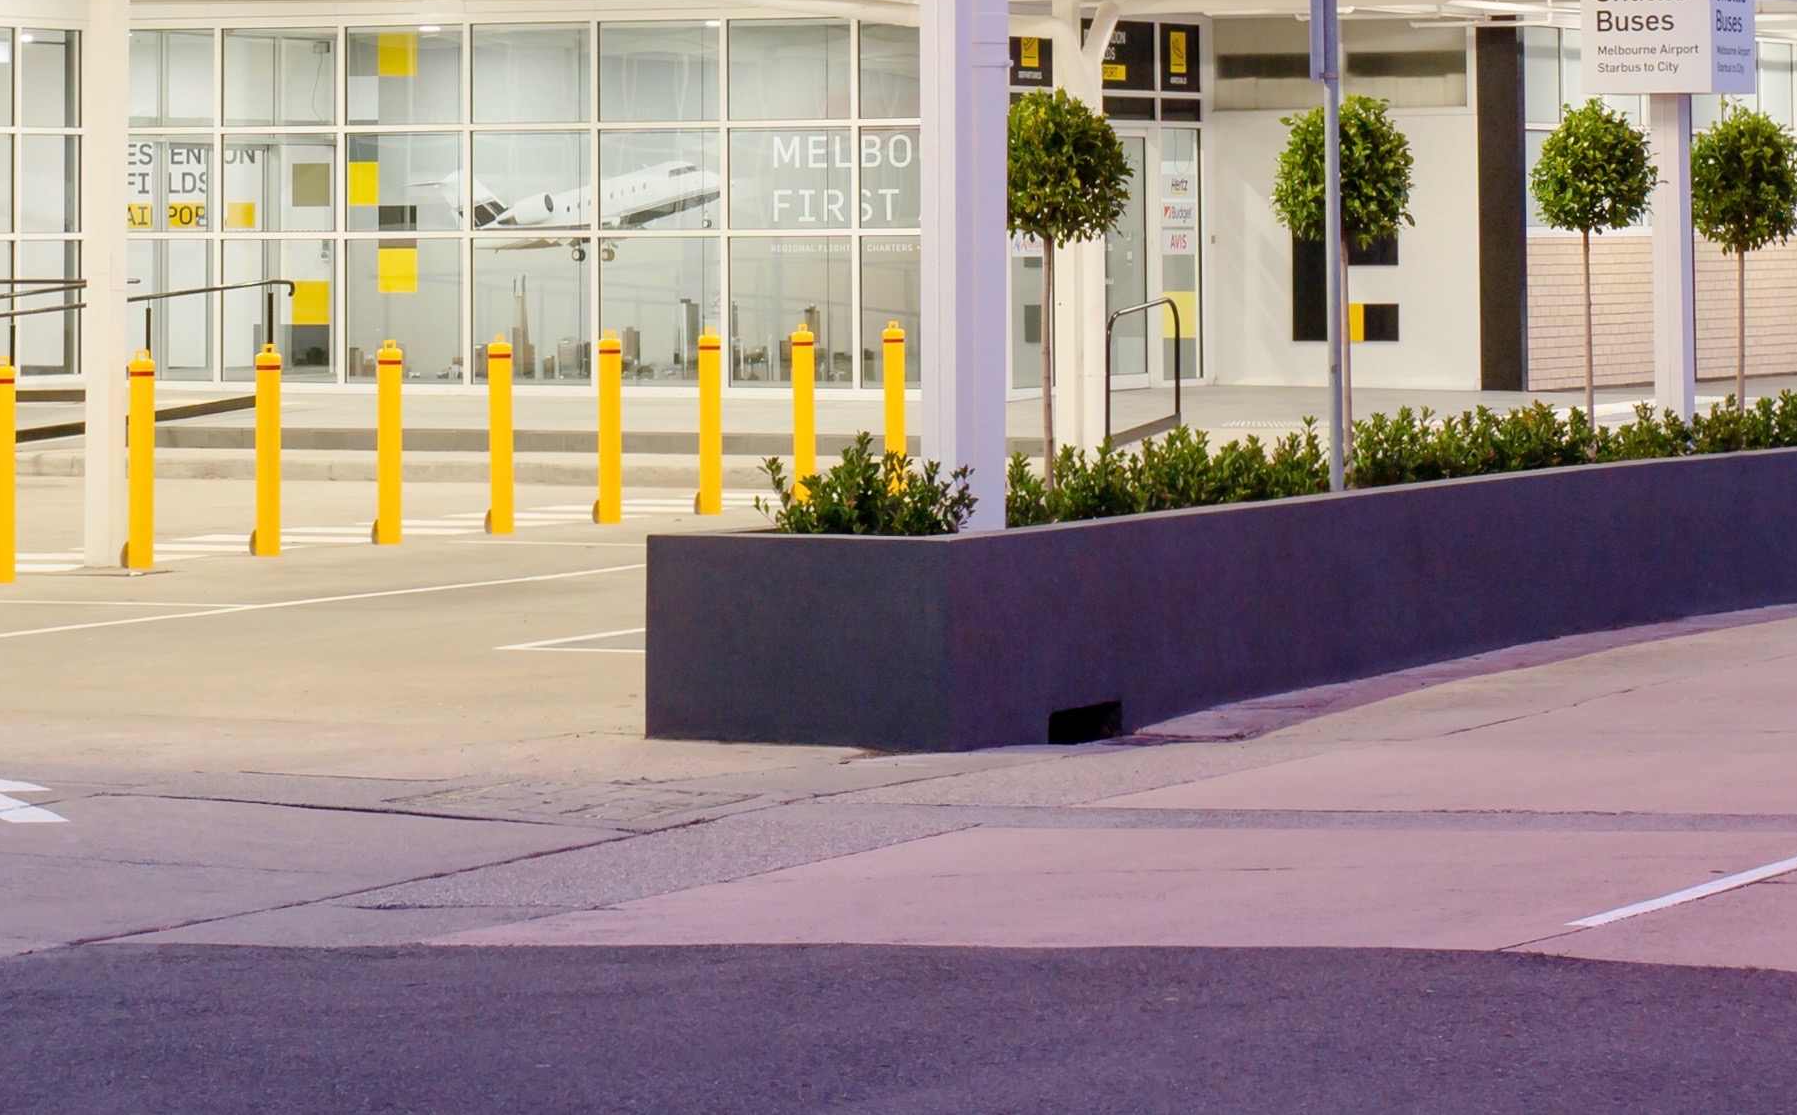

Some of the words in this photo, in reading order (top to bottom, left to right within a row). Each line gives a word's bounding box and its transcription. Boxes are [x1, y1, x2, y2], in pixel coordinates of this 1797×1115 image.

[1596, 10, 1675, 32] Buses
[1715, 9, 1743, 33] Buses
[1597, 44, 1657, 56] Melbourne
[1660, 44, 1699, 56] Airport
[1597, 62, 1641, 73] Starbus
[1644, 62, 1655, 72] to
[1657, 61, 1679, 74] City
[128, 143, 256, 165] ESENON
[773, 134, 921, 168] MELBO
[128, 172, 206, 194] FILDS
[1171, 178, 1188, 192] Hertz
[773, 188, 900, 222] FIRST
[1171, 206, 1192, 224] Budget
[770, 244, 815, 253] REGIONAL
[818, 244, 852, 253] FLIGHT
[867, 243, 913, 253] CHARTERS
[1170, 236, 1187, 249] AVIS
